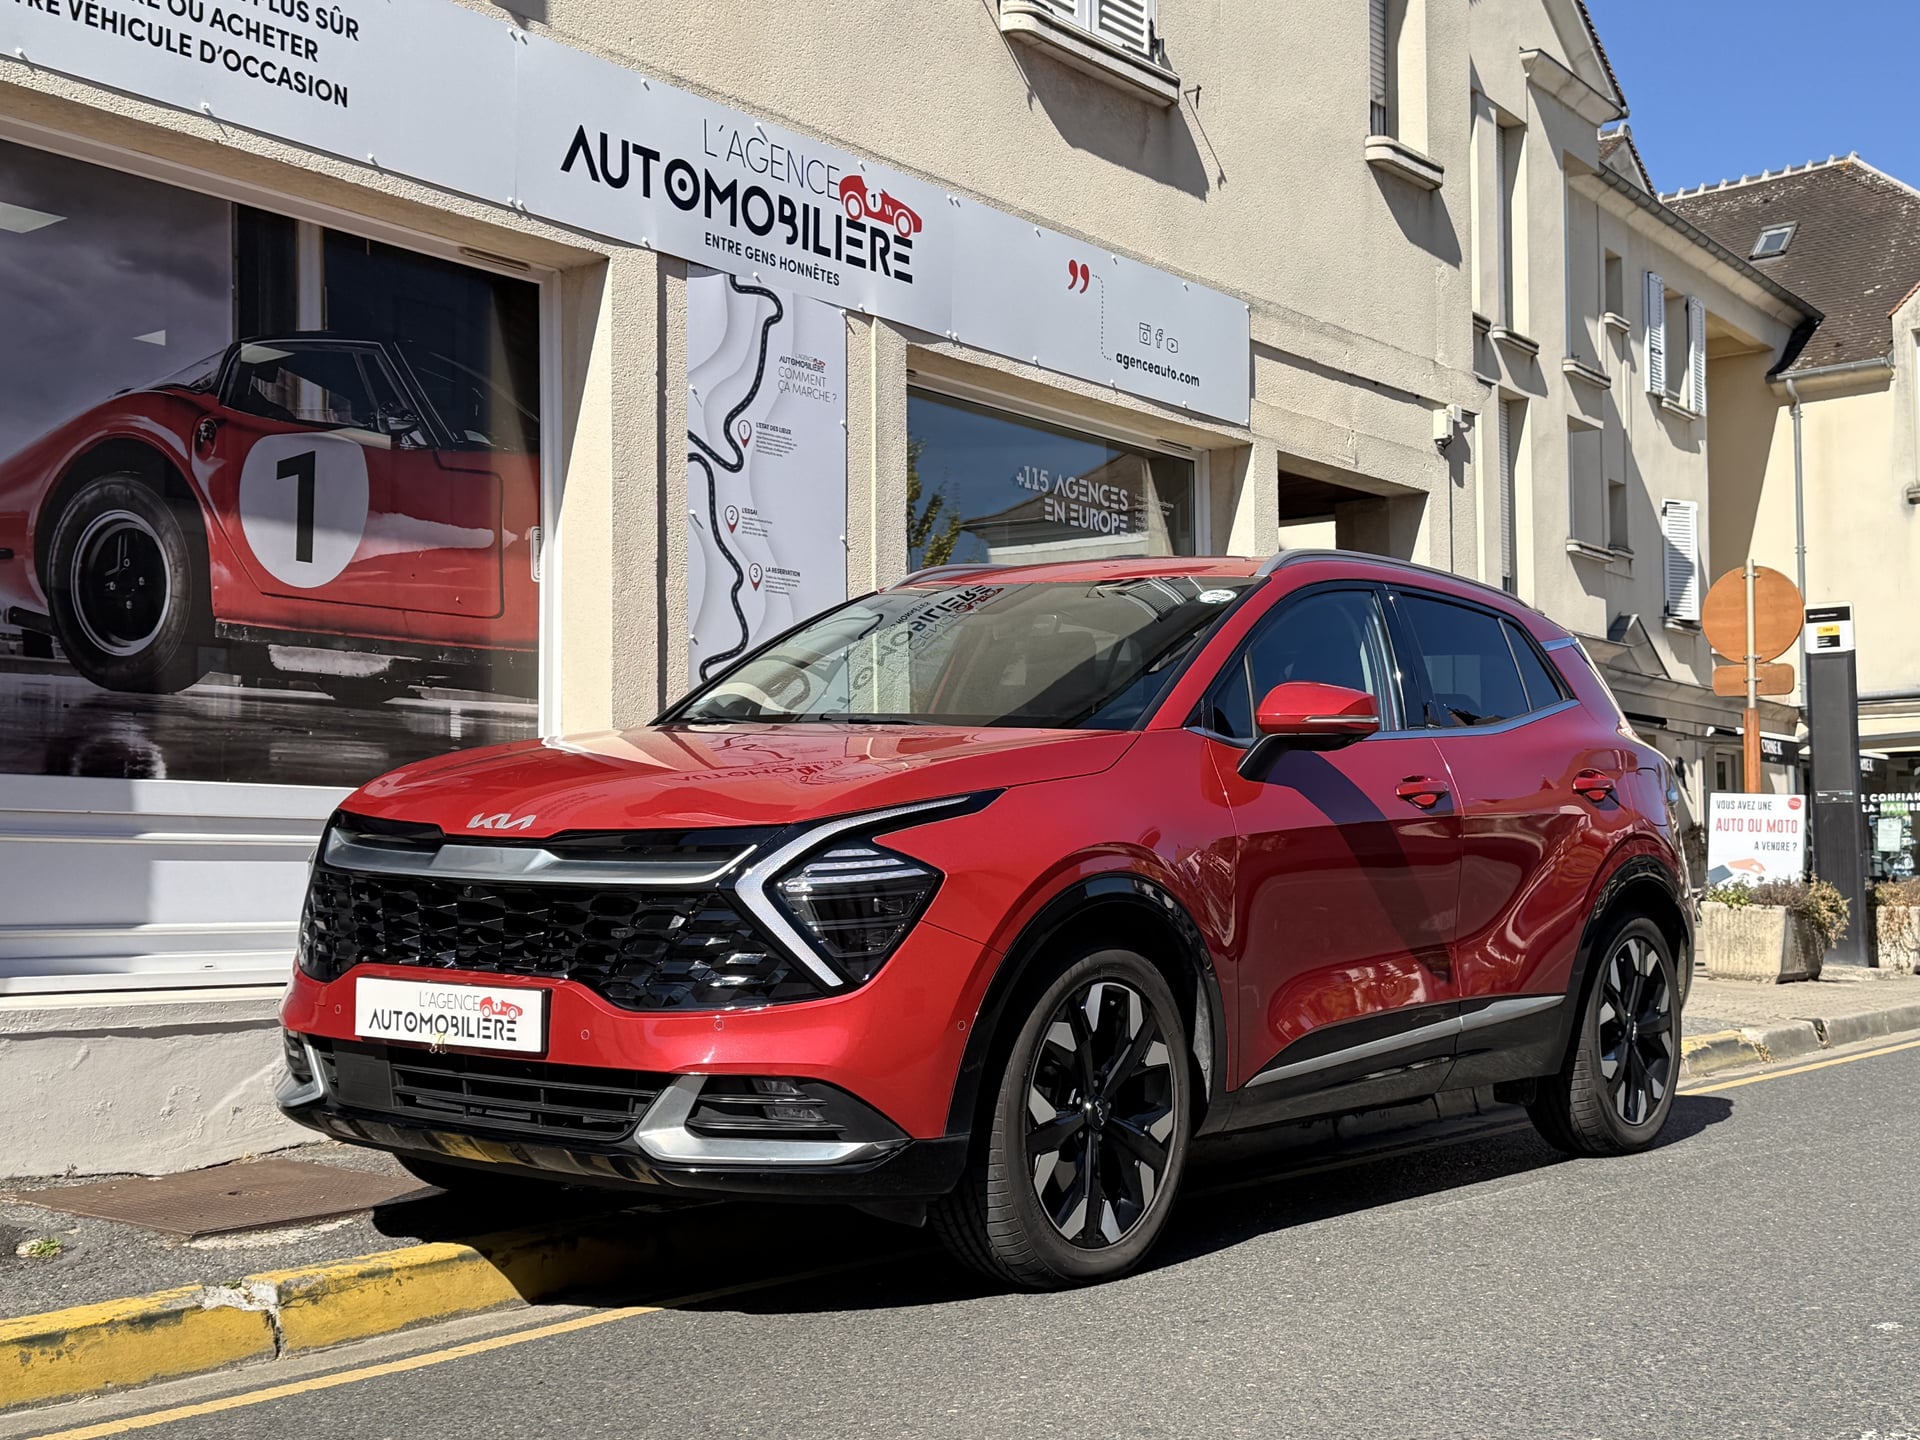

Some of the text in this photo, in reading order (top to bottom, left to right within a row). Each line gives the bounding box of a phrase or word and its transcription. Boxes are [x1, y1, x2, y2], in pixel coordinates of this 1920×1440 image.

[167, 0, 318, 63] OU ACHETER
[315, 5, 359, 41] SÛR
[200, 40, 348, 108] D'OCCASION
[704, 118, 840, 201] L'AGENCE
[705, 232, 840, 287] ENTRE GENS HONNÊTES
[778, 366, 827, 387] COMMENT
[1116, 352, 1200, 387] agenceauto.com
[778, 379, 791, 394] ÇA
[792, 383, 831, 403] MARCHE
[1016, 465, 1129, 512] +115 AGENCES
[276, 450, 316, 564] 1
[729, 509, 735, 520] 2
[1044, 497, 1066, 524] EN
[1070, 504, 1129, 537] EUROPE
[753, 567, 759, 578] 3
[1716, 799, 1772, 811] VOUS AVEZ UNE
[466, 812, 537, 831] KIA
[1715, 817, 1798, 834] AUTO OU MOTO
[1761, 841, 1790, 852] VENDRE
[1792, 842, 1797, 852] ?
[419, 991, 481, 1012] L'AGENCE
